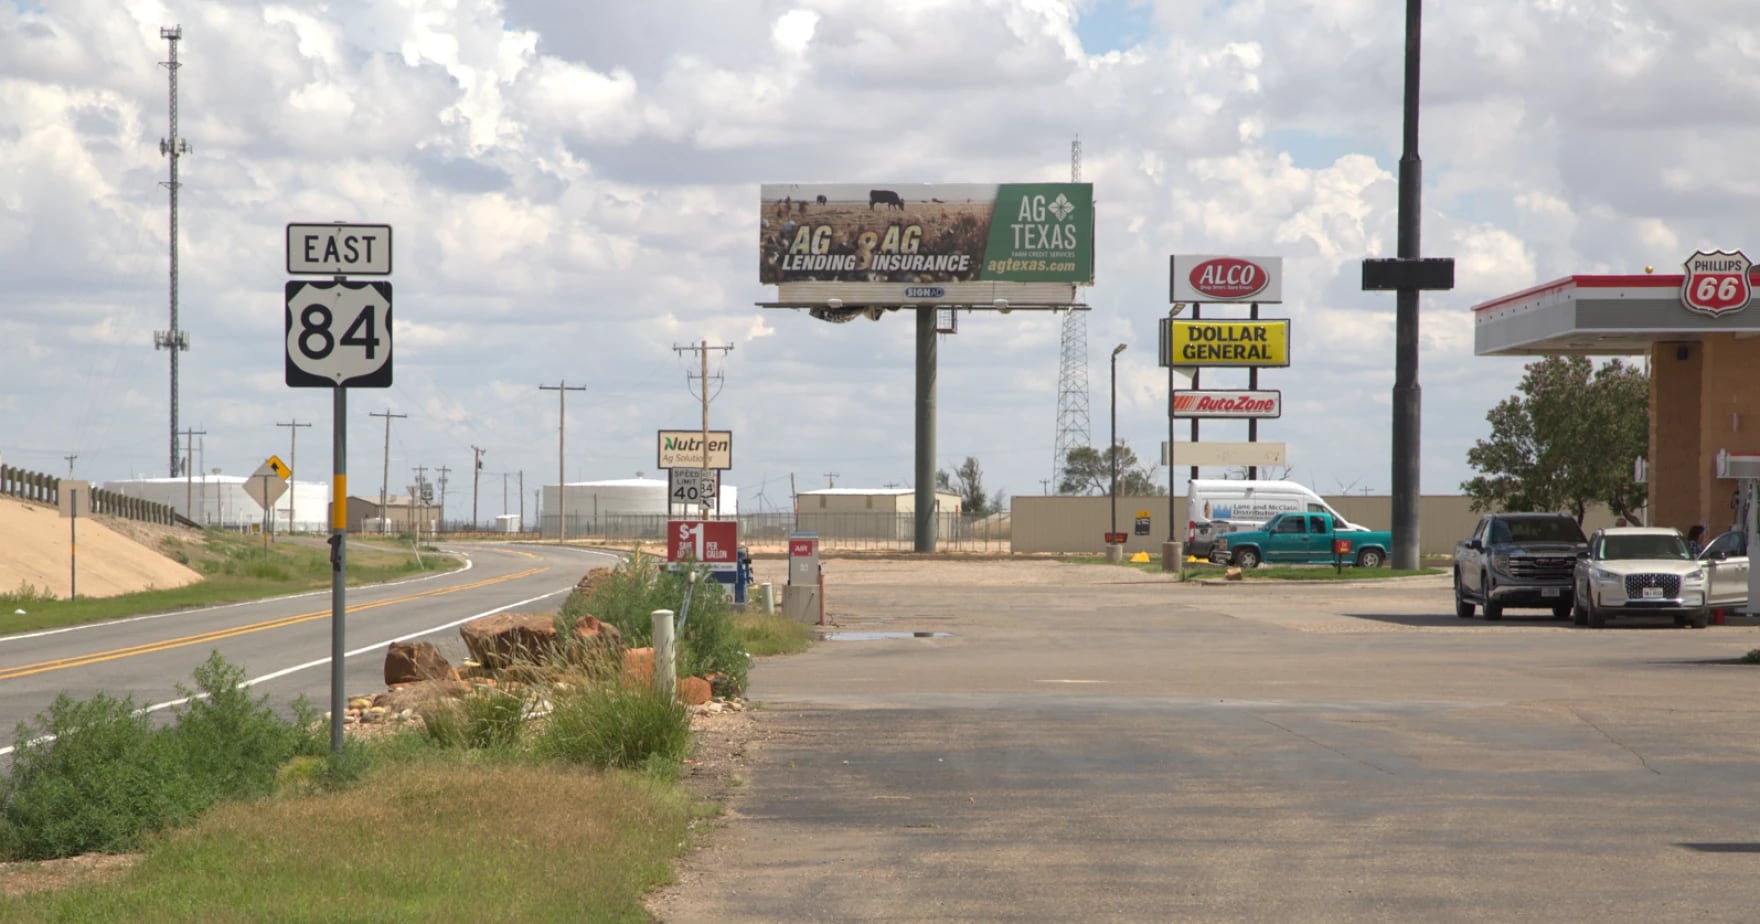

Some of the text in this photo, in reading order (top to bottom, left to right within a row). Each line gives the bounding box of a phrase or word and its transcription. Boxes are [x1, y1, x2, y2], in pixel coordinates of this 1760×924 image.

[1018, 195, 1046, 222] AG
[789, 225, 833, 255] AG
[880, 225, 922, 255] AG
[1010, 223, 1077, 250] TEXAS
[304, 235, 376, 264] EAST
[782, 254, 971, 271] LENDING INSURANCE
[987, 257, 1076, 275] agtexas.com
[1694, 260, 1743, 272] PHILLIPS
[1199, 264, 1255, 285] ALCO
[1696, 276, 1739, 301] 66
[298, 303, 380, 360] 84
[1188, 326, 1267, 342] DOLLAR
[1182, 344, 1272, 360] GENERAL
[1196, 396, 1275, 411] AutoZone
[664, 436, 728, 452] Nutren
[662, 454, 674, 464] Ag
[674, 470, 700, 478] SPEED
[673, 486, 699, 500] 40
[679, 522, 704, 561] $1
[706, 541, 718, 550] PER
[706, 550, 729, 559] GALLON
